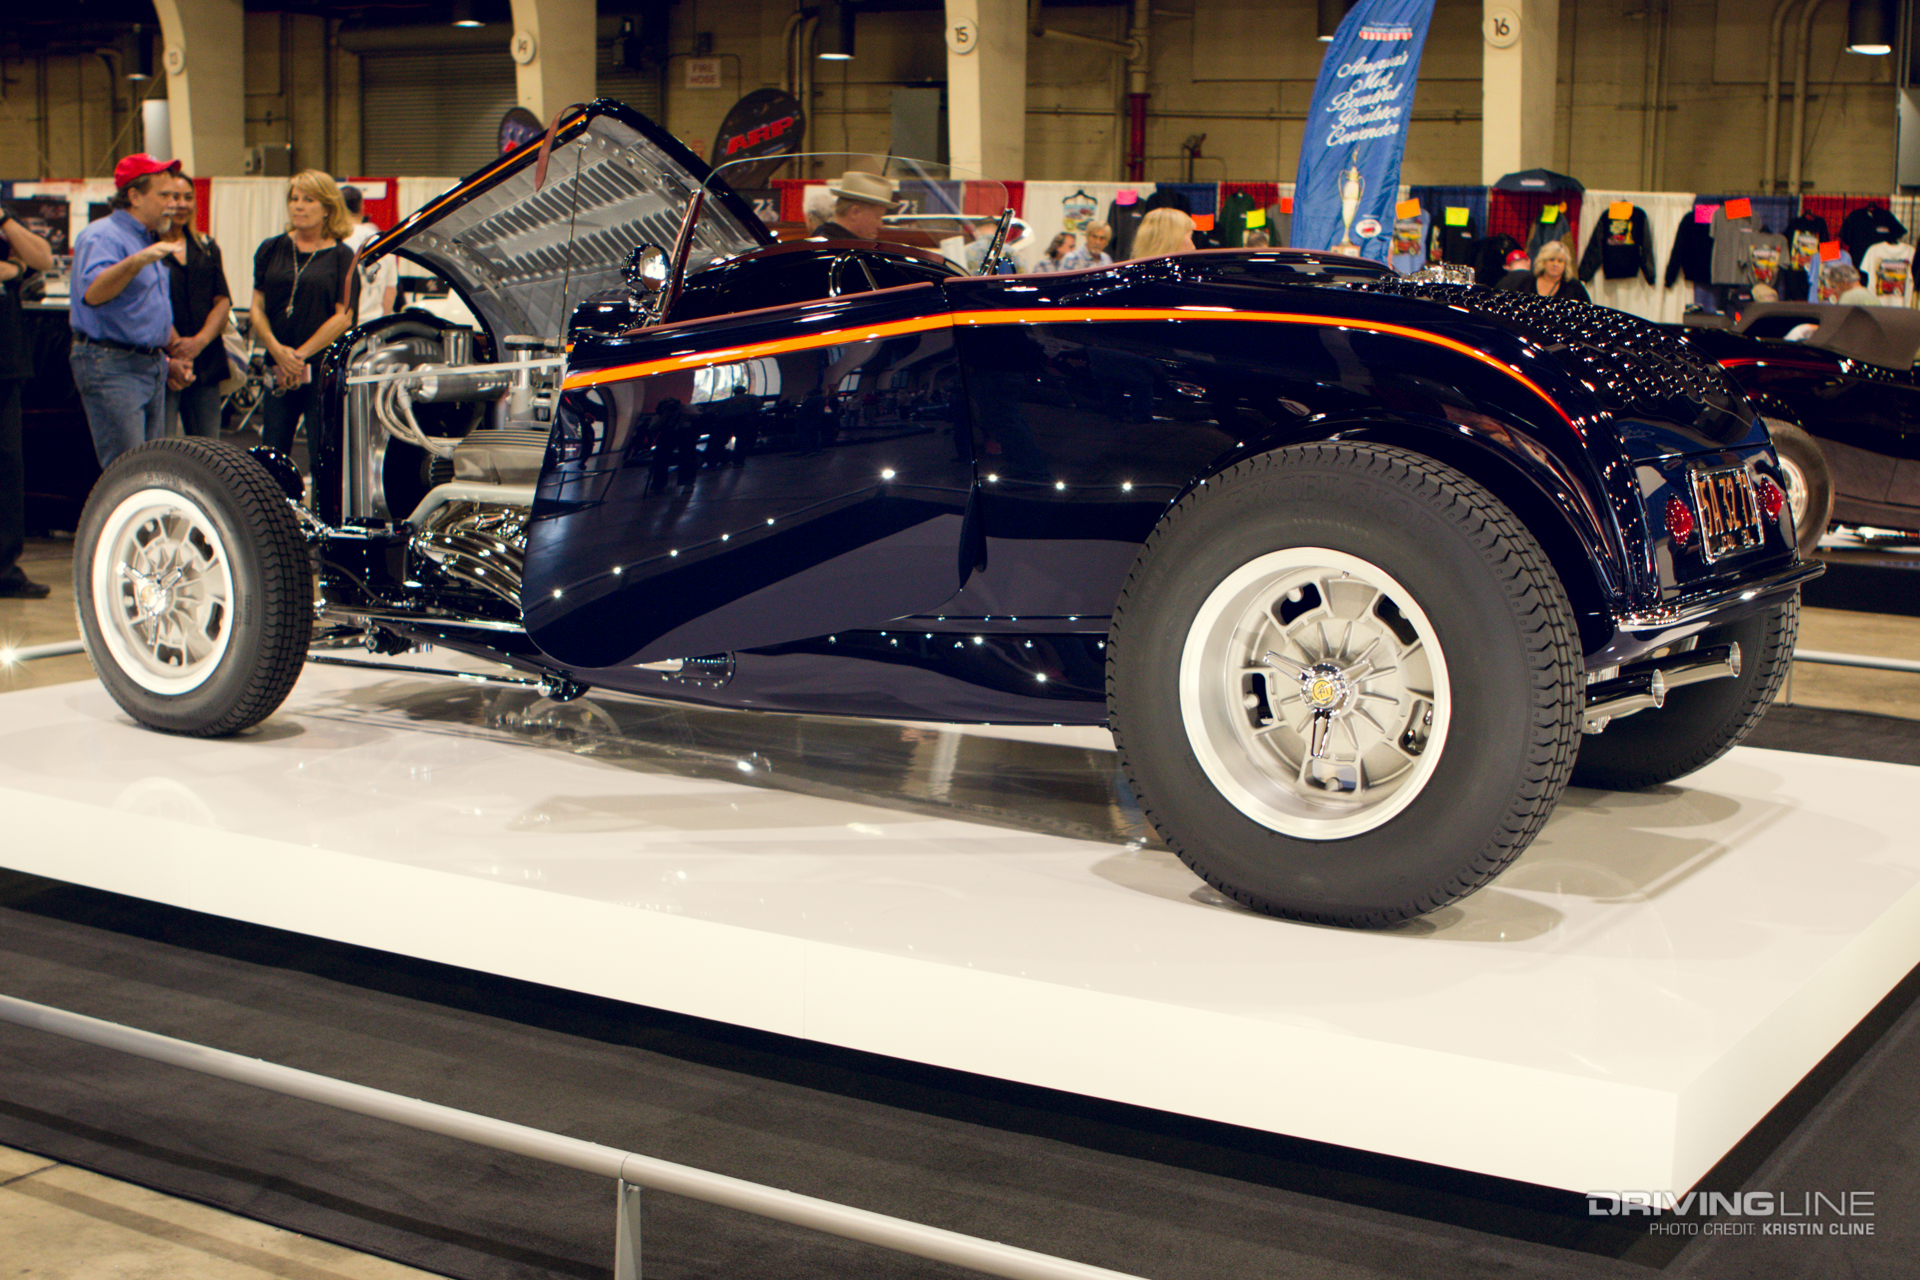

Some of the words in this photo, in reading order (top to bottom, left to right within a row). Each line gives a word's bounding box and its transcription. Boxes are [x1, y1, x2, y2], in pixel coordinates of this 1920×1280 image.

[954, 26, 969, 43] 15
[1493, 17, 1510, 36] 16
[1349, 70, 1394, 93] Most
[1326, 82, 1404, 112] Beautiful
[1331, 105, 1401, 130] Roadster
[725, 116, 794, 156] ARP
[1326, 120, 1400, 147] Contender
